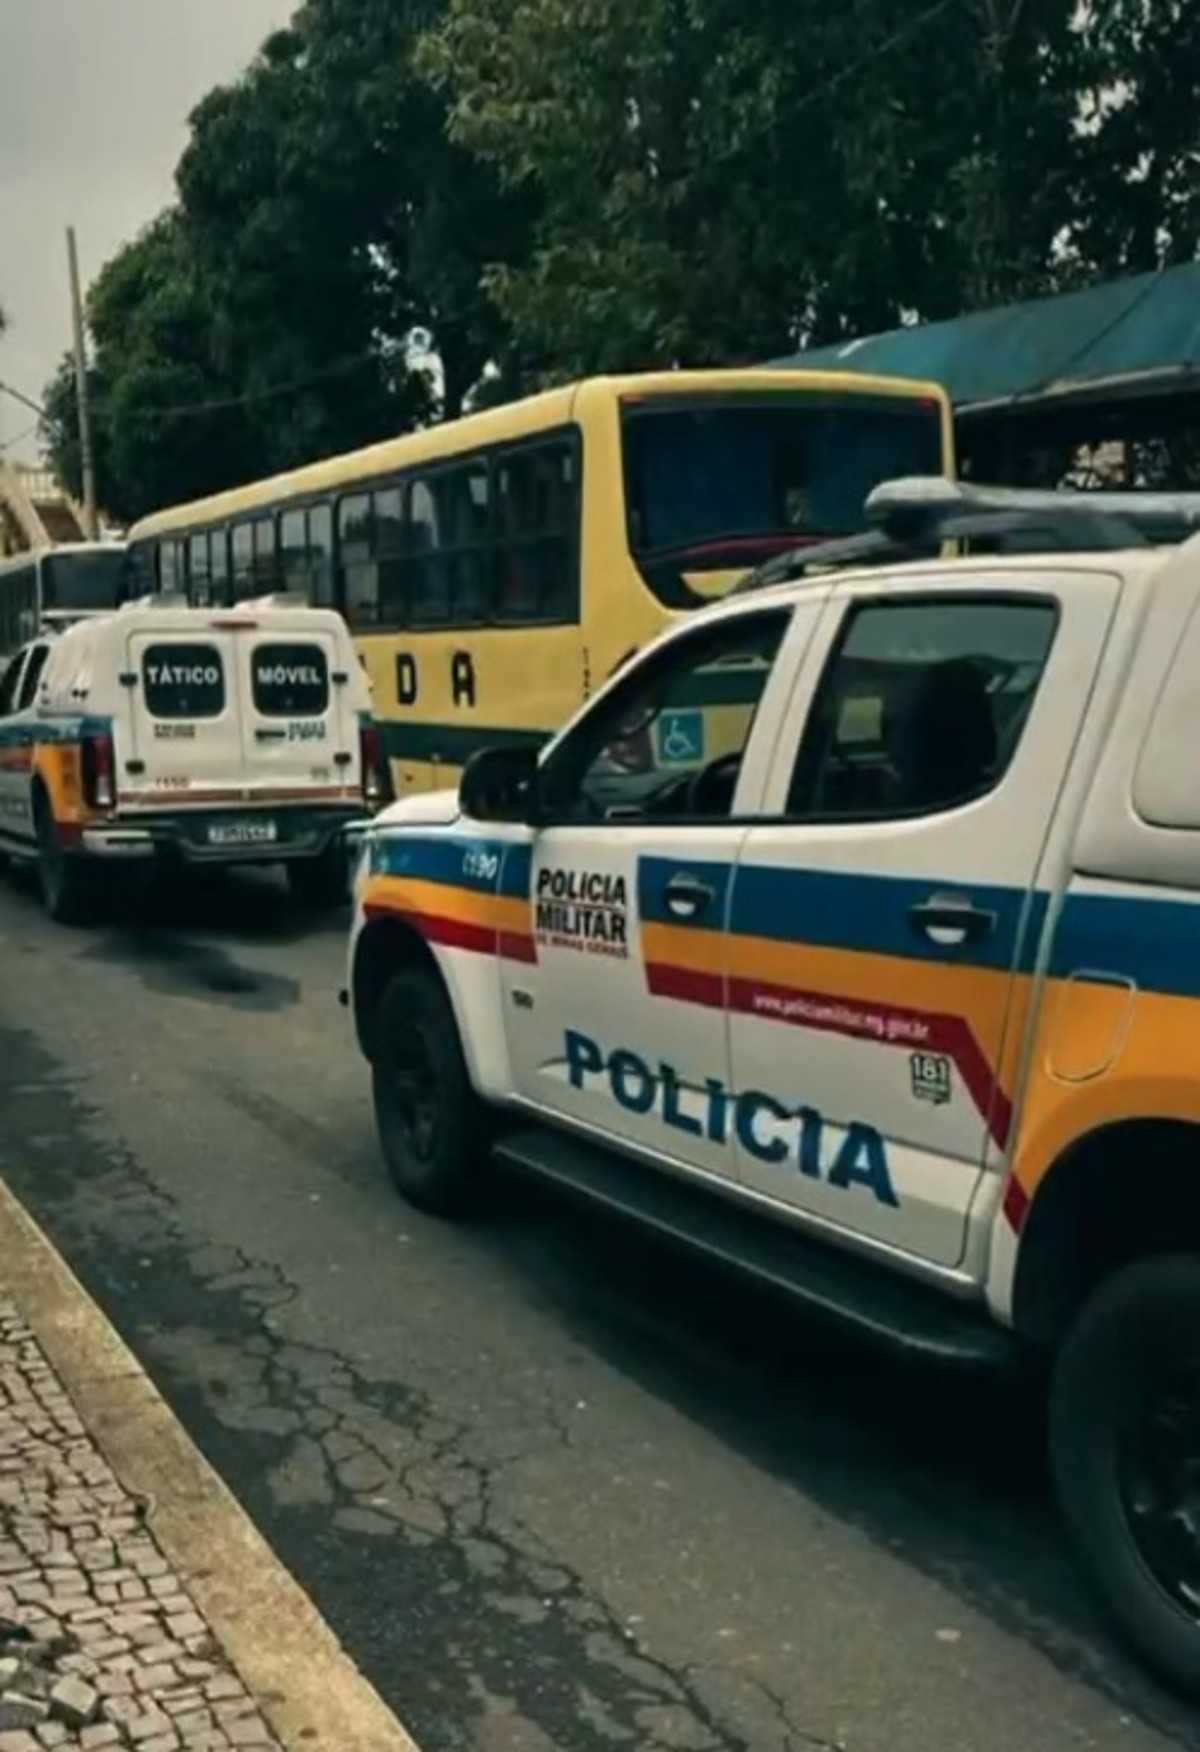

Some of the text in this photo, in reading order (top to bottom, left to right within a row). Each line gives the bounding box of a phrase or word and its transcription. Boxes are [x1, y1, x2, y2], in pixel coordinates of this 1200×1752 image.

[147, 662, 321, 684] TÁTICO MÓVEL
[536, 903, 626, 942] MILITAR
[912, 1056, 948, 1082] 181
